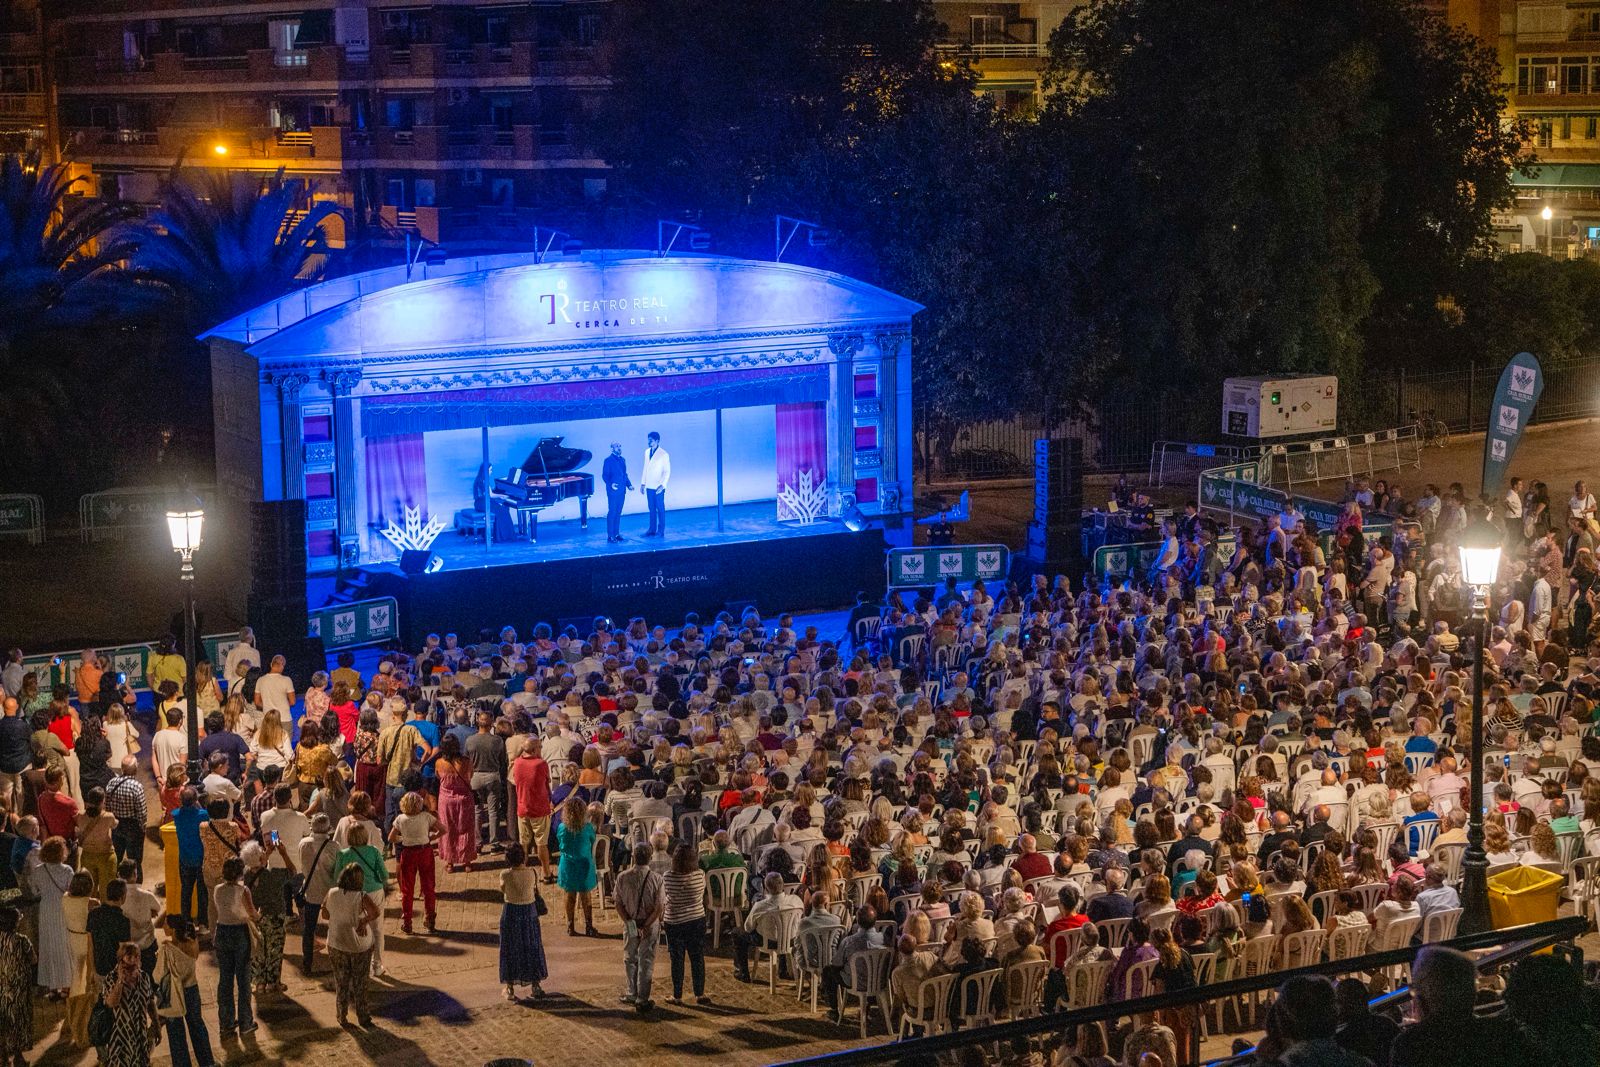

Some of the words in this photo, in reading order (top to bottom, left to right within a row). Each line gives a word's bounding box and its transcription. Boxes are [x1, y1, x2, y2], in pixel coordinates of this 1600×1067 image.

[575, 299, 627, 313] TEATRO
[633, 296, 668, 310] REAL
[575, 320, 620, 328] CERCA
[630, 317, 645, 325] DE
[1309, 510, 1324, 521] CAJA
[1324, 513, 1338, 524] RUR
[667, 576, 691, 584] TEATRO
